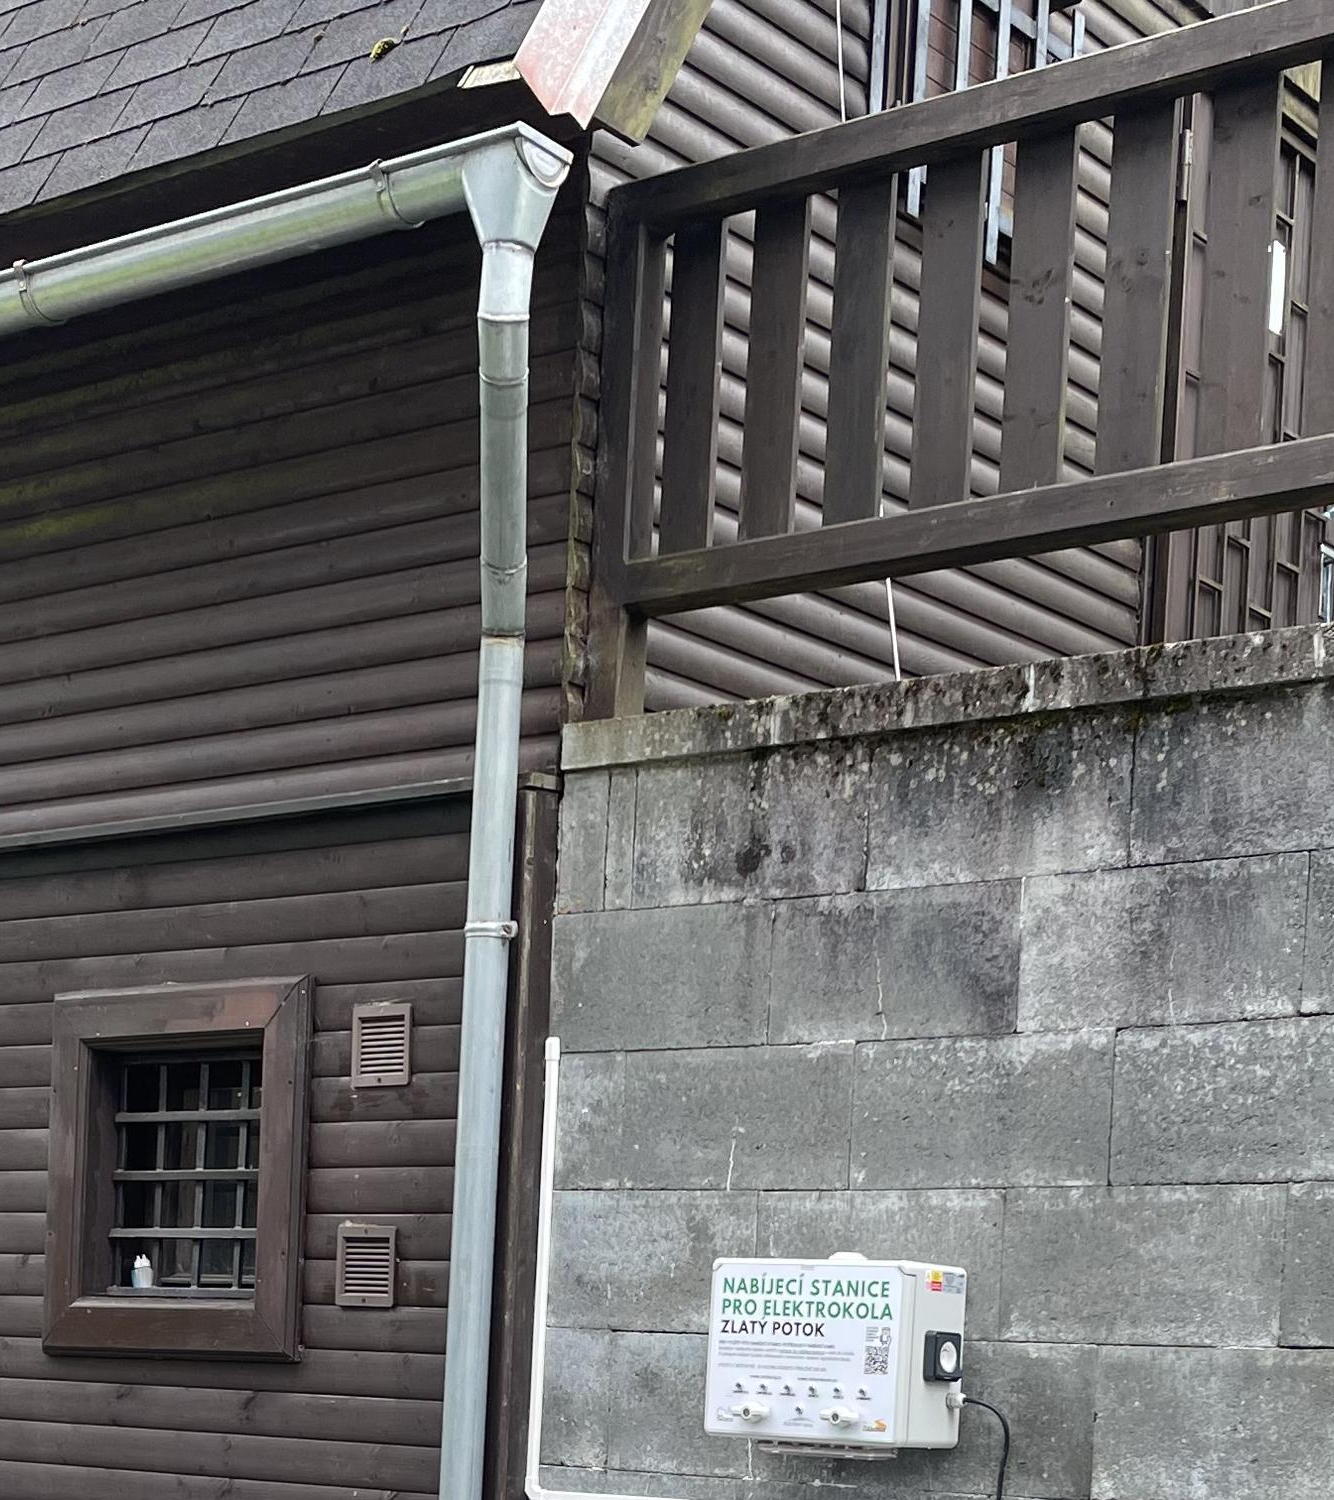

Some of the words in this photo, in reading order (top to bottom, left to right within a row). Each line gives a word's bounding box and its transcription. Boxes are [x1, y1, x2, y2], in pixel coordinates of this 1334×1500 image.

[722, 1272, 805, 1295] NABÍJECÍ
[810, 1279, 890, 1298] STANICE
[722, 1298, 757, 1316] PRO
[763, 1299, 893, 1321] ELEKTROKOLA
[772, 1321, 825, 1337] POTOK
